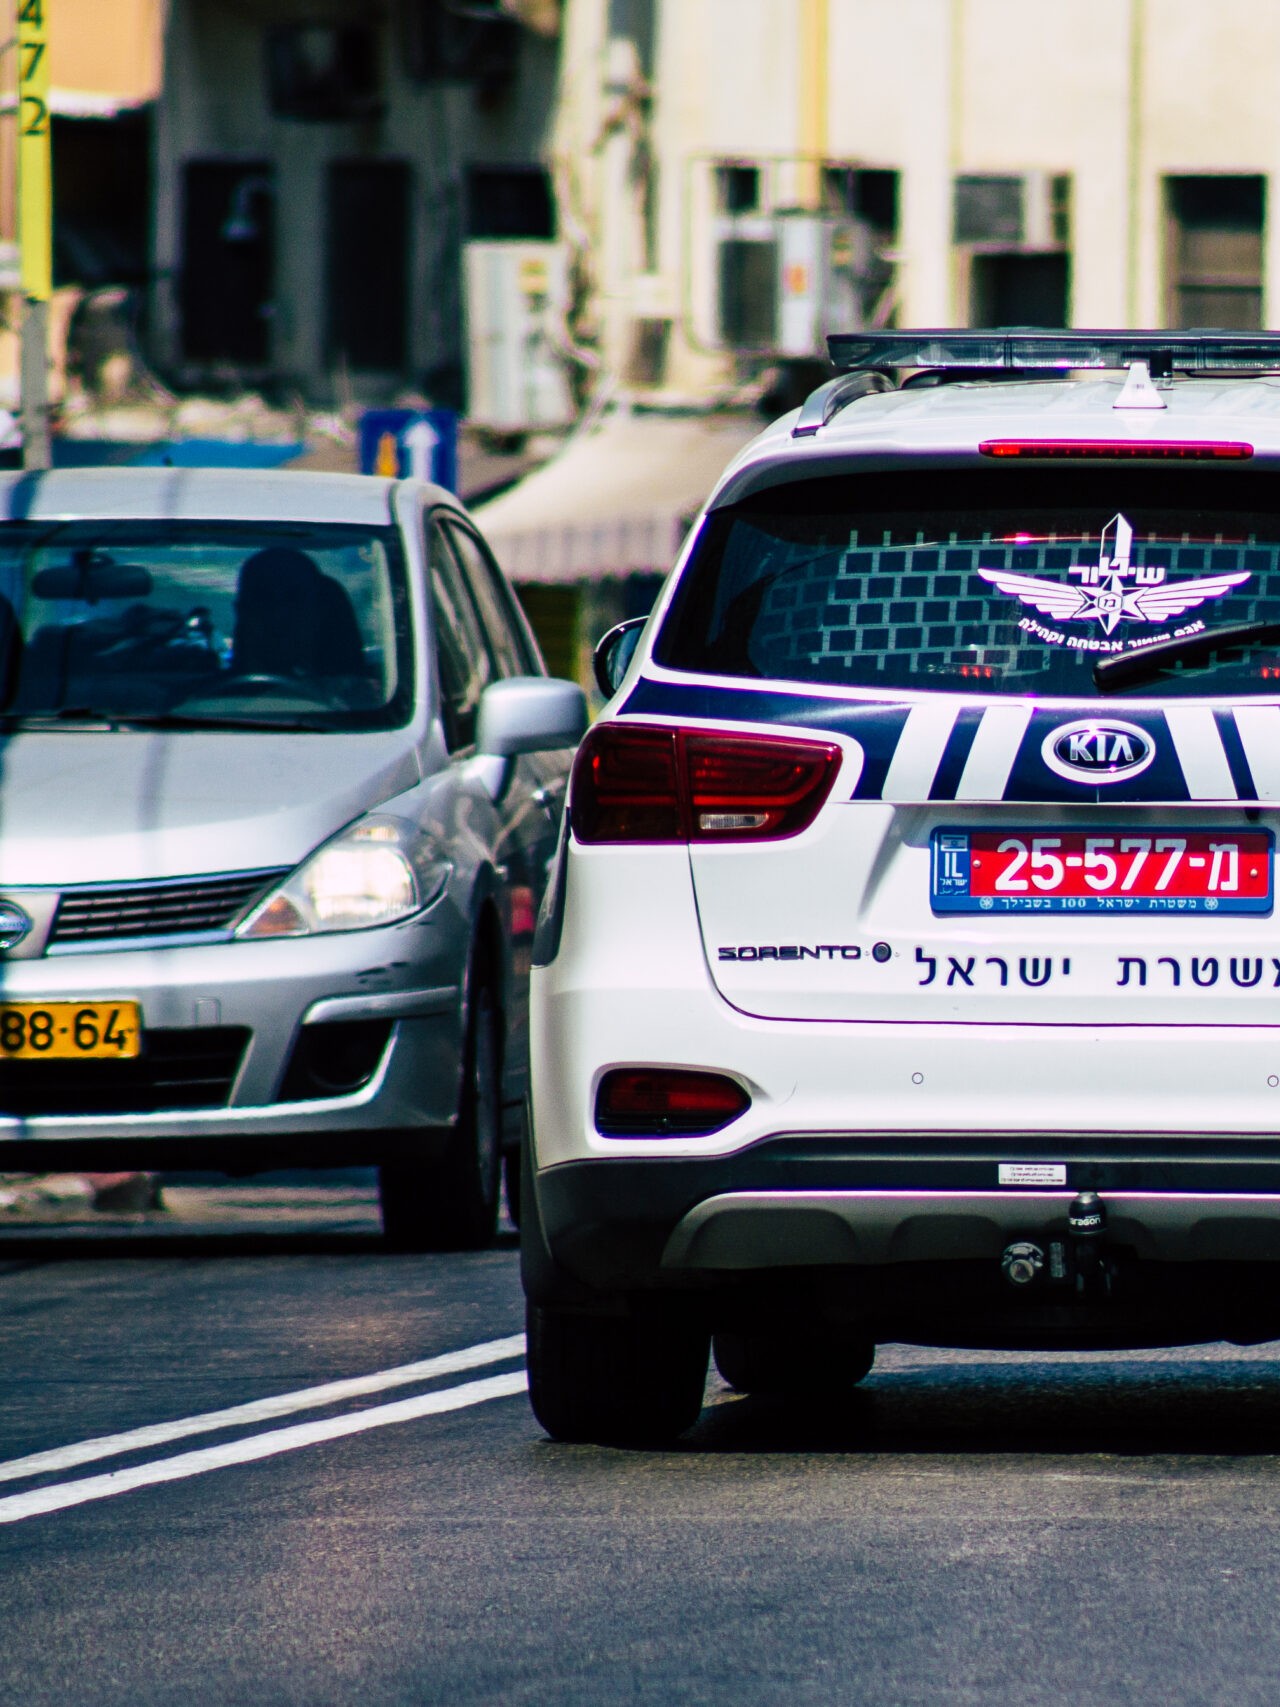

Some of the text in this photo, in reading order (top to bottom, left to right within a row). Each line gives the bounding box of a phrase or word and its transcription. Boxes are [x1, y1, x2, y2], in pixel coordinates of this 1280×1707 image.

[1018, 617, 1065, 644] וקהילה
[1067, 636, 1123, 651] אבטחה
[1069, 734, 1134, 762] KIA
[944, 852, 963, 878] IL
[940, 878, 968, 886] ישראל
[1002, 896, 1197, 909] משטרת ישראל 100 בשבילך
[718, 945, 861, 961] SORENTO
[915, 947, 1071, 987] ישראל
